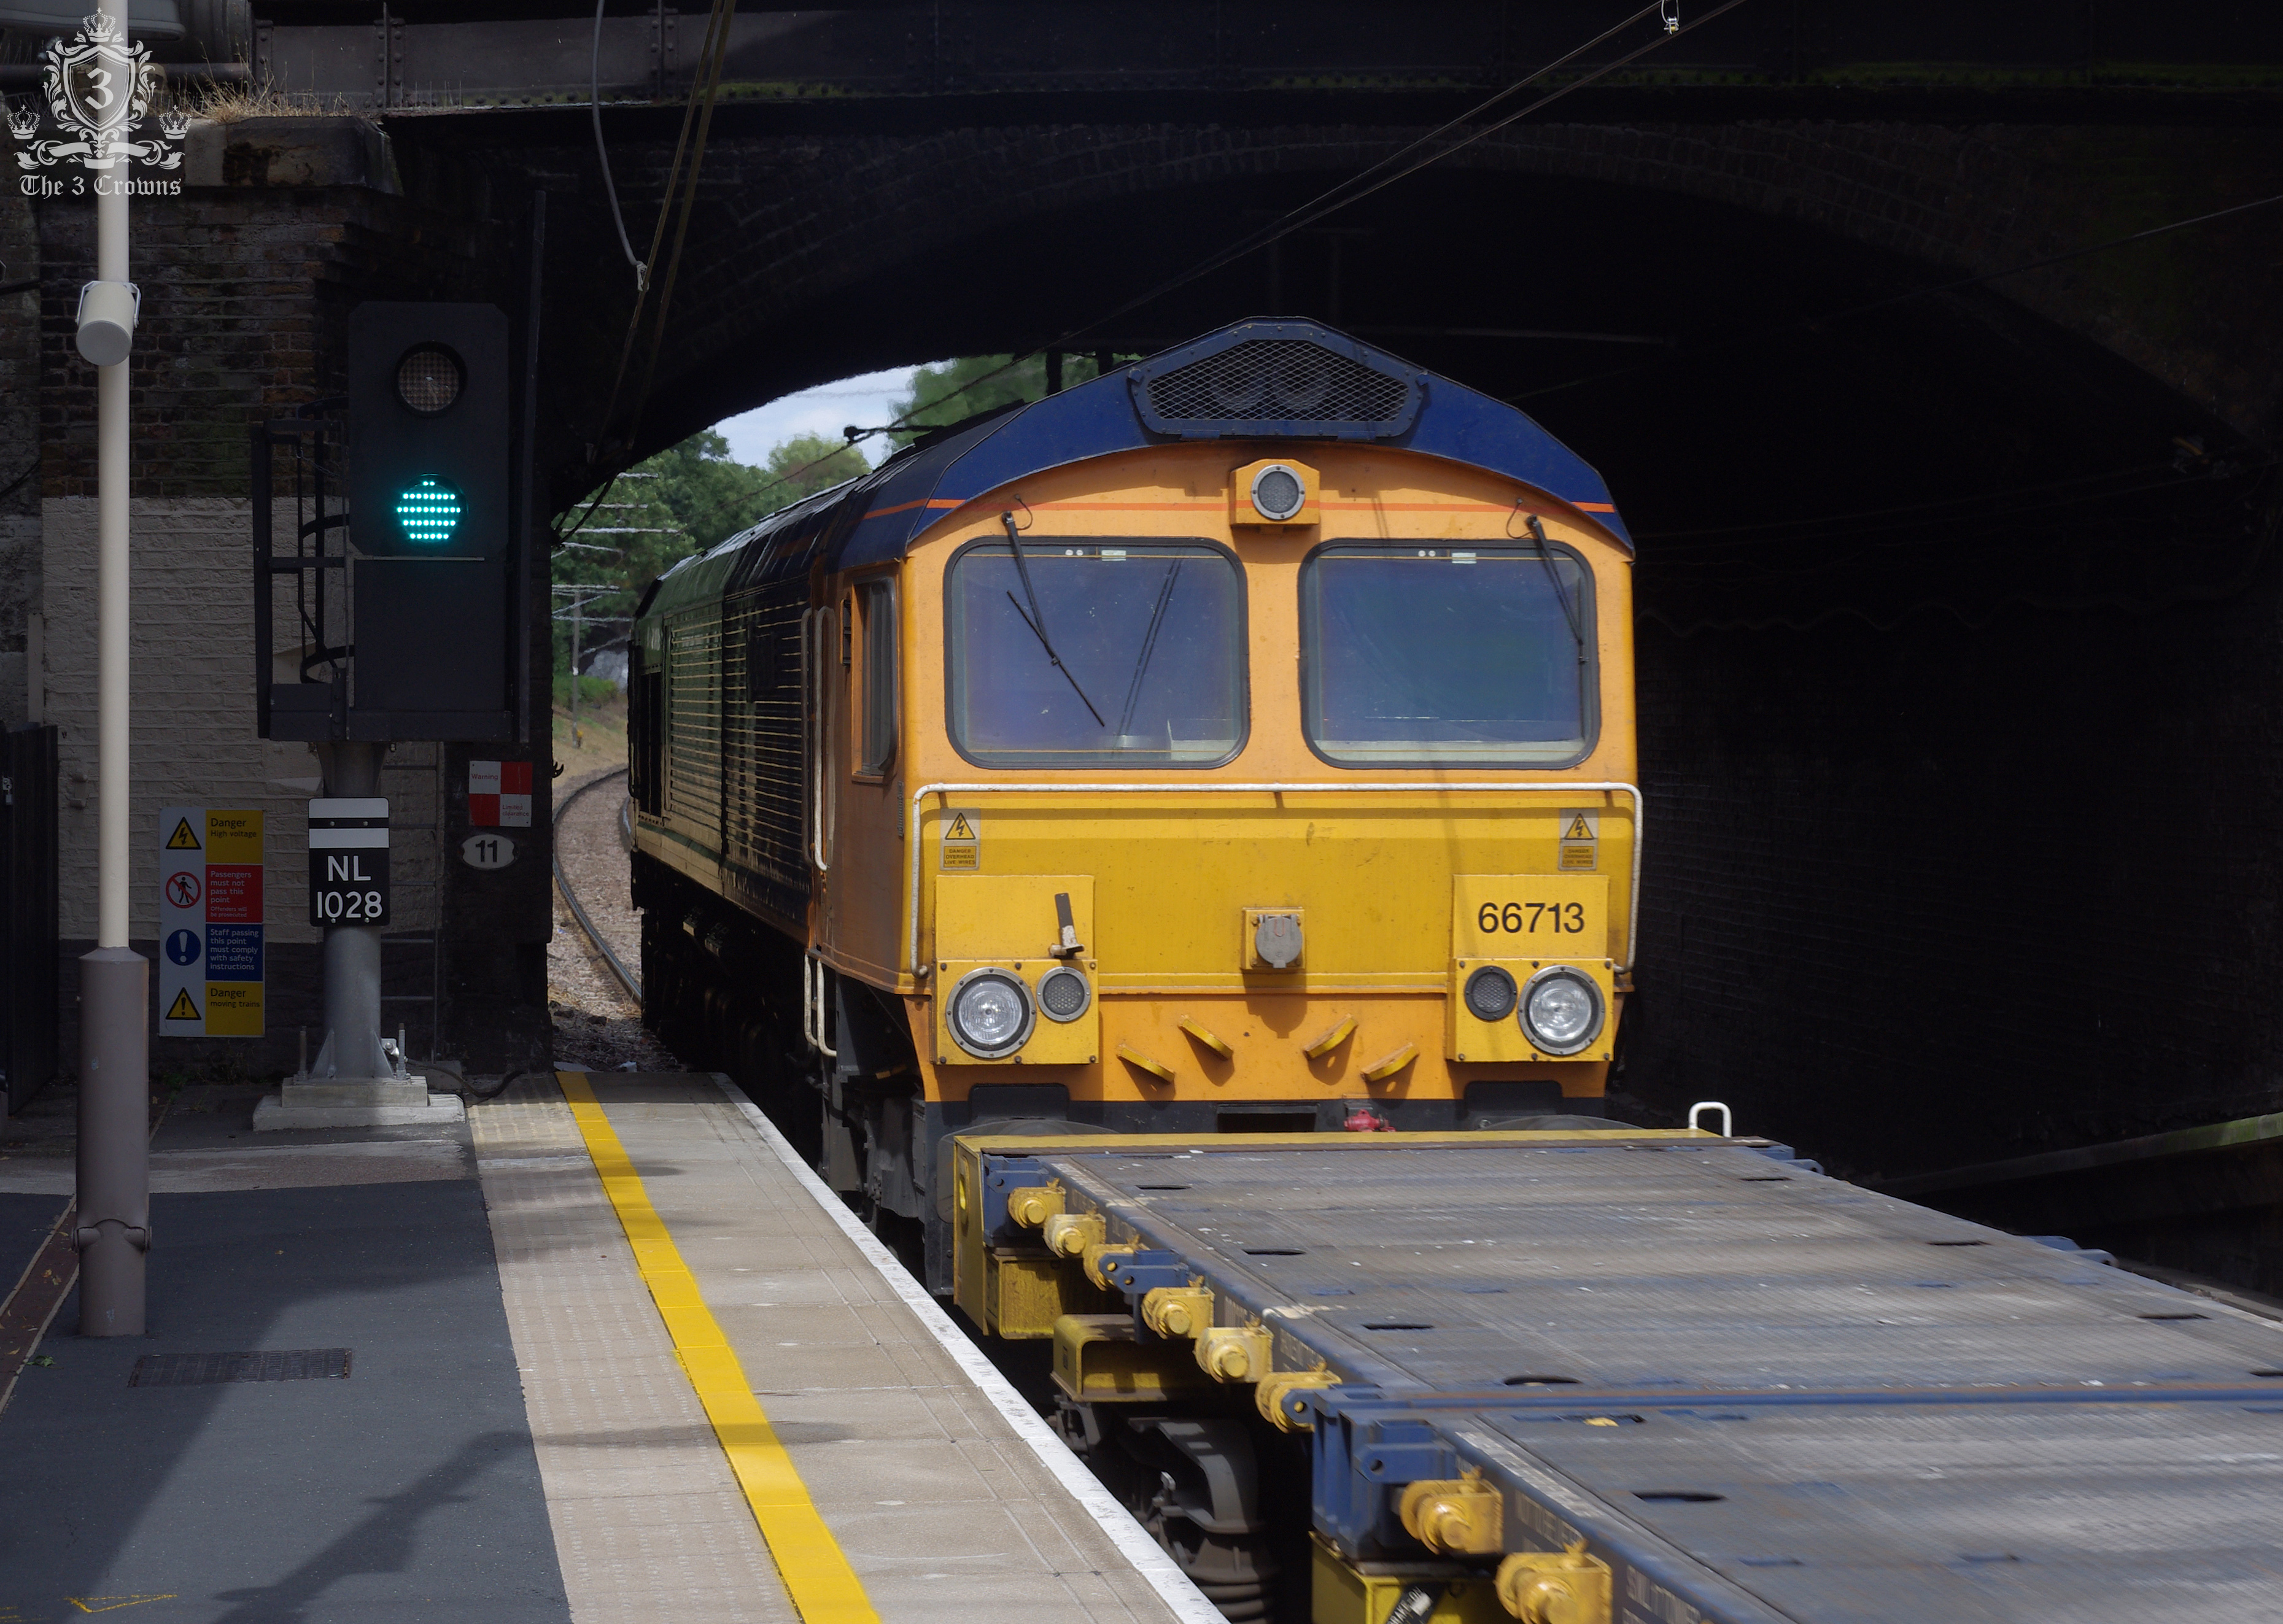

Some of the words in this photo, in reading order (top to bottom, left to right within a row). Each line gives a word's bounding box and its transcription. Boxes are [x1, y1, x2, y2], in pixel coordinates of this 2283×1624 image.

[211, 818, 247, 829] Danger
[211, 830, 228, 839] High
[230, 830, 257, 839] voltage
[475, 840, 498, 862] 11
[327, 855, 371, 881] NL
[211, 870, 252, 880] Passengers
[317, 891, 383, 918] 1028
[1478, 902, 1585, 934] 66713
[231, 929, 259, 938] passing
[229, 954, 254, 963] safety
[211, 988, 246, 999] Danger
